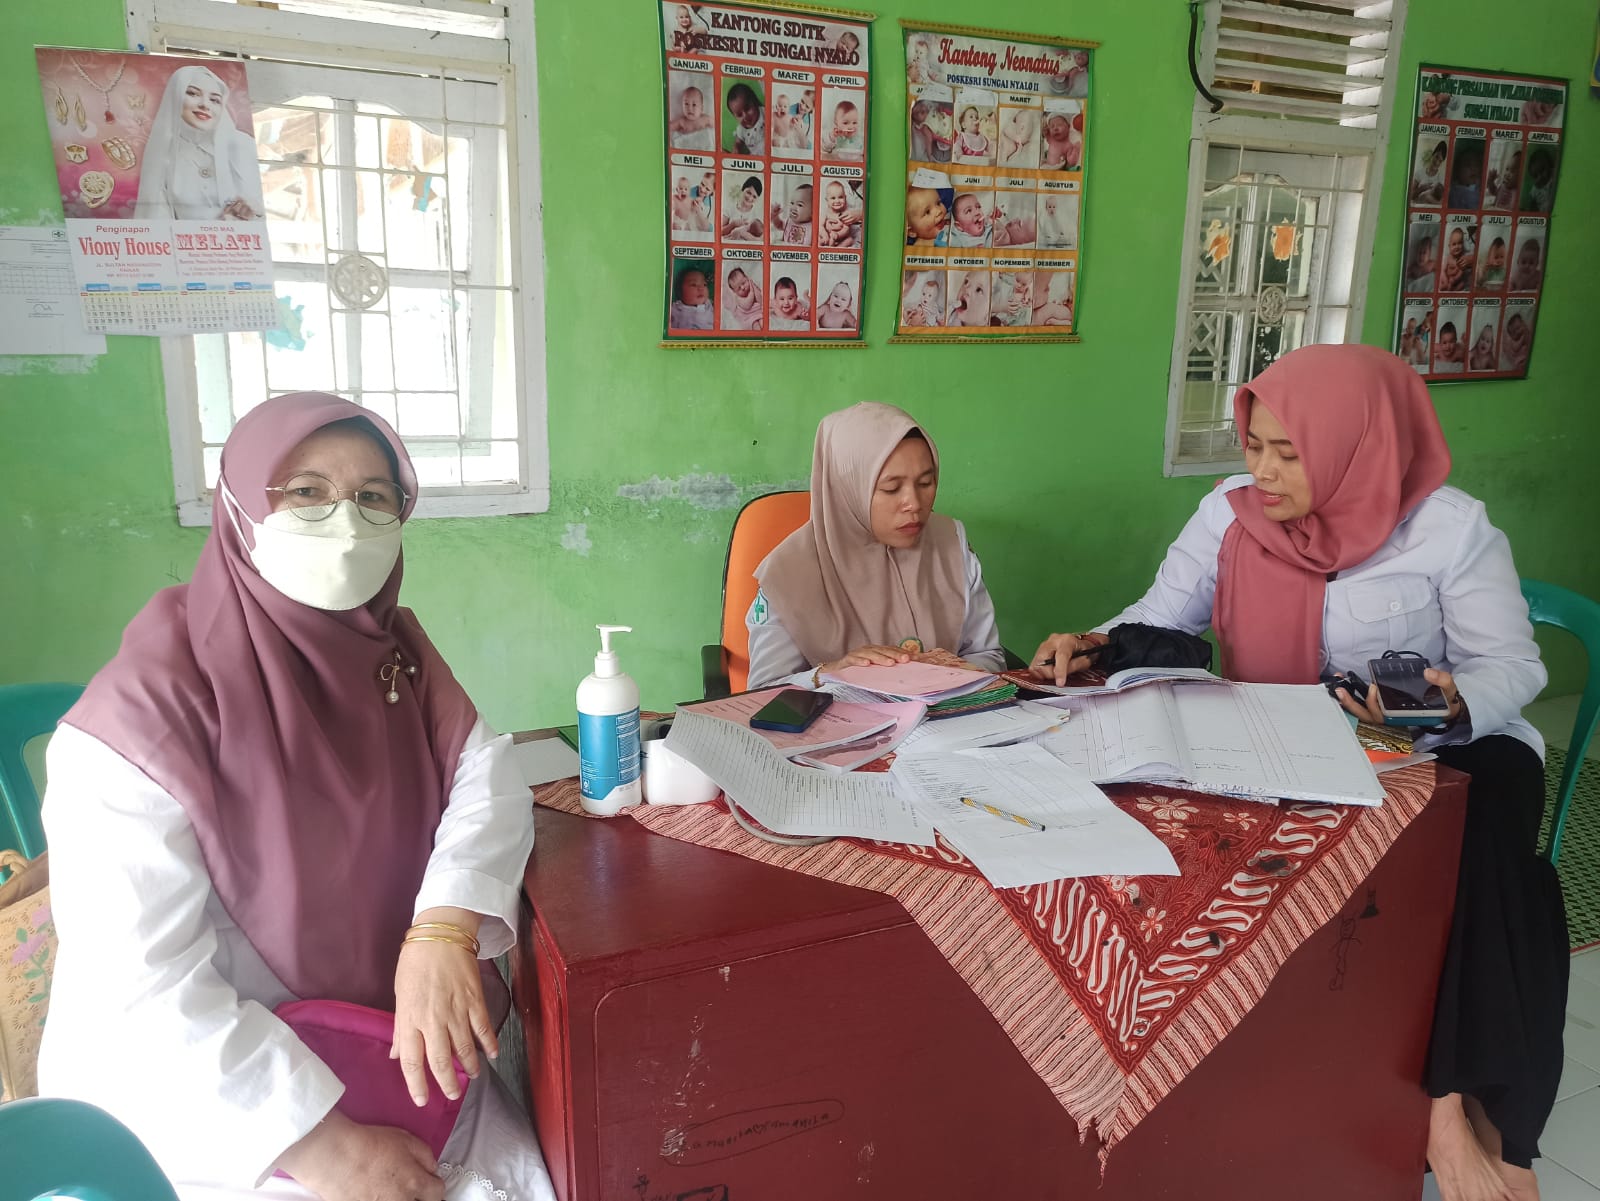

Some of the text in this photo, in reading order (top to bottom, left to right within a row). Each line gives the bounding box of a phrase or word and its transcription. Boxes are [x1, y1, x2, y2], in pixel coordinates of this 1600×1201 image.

[711, 12, 826, 41] KANTONG SDITK
[674, 31, 860, 66] POSKESRI II SUNGAI NYALO
[938, 38, 1060, 76] Kantong Neonatus
[673, 59, 860, 86] JANUARI FEBRUARI MARET ARPRIL
[946, 74, 981, 86] POSKESRI
[983, 77, 1009, 89] SUNGAI
[1010, 80, 1033, 91] NYALO
[1009, 95, 1031, 104] MARET
[1421, 126, 1447, 134] JANUARI
[1457, 127, 1484, 136] FEBRUARI
[1495, 131, 1520, 139] MARET
[684, 156, 861, 176] MEI JUNI JULI AGUSTUS
[964, 177, 980, 185] JUNI
[1418, 214, 1432, 222] MEI
[1518, 218, 1544, 226] AGUSTUS
[96, 225, 150, 235] Penginapan
[78, 237, 121, 260] Viony
[126, 237, 171, 257] House
[175, 234, 263, 251] MELATI
[674, 247, 858, 262] SEPTEMBER OKTOBER NOVEMBER DESEMBER
[906, 257, 944, 265] SEPTEMBER
